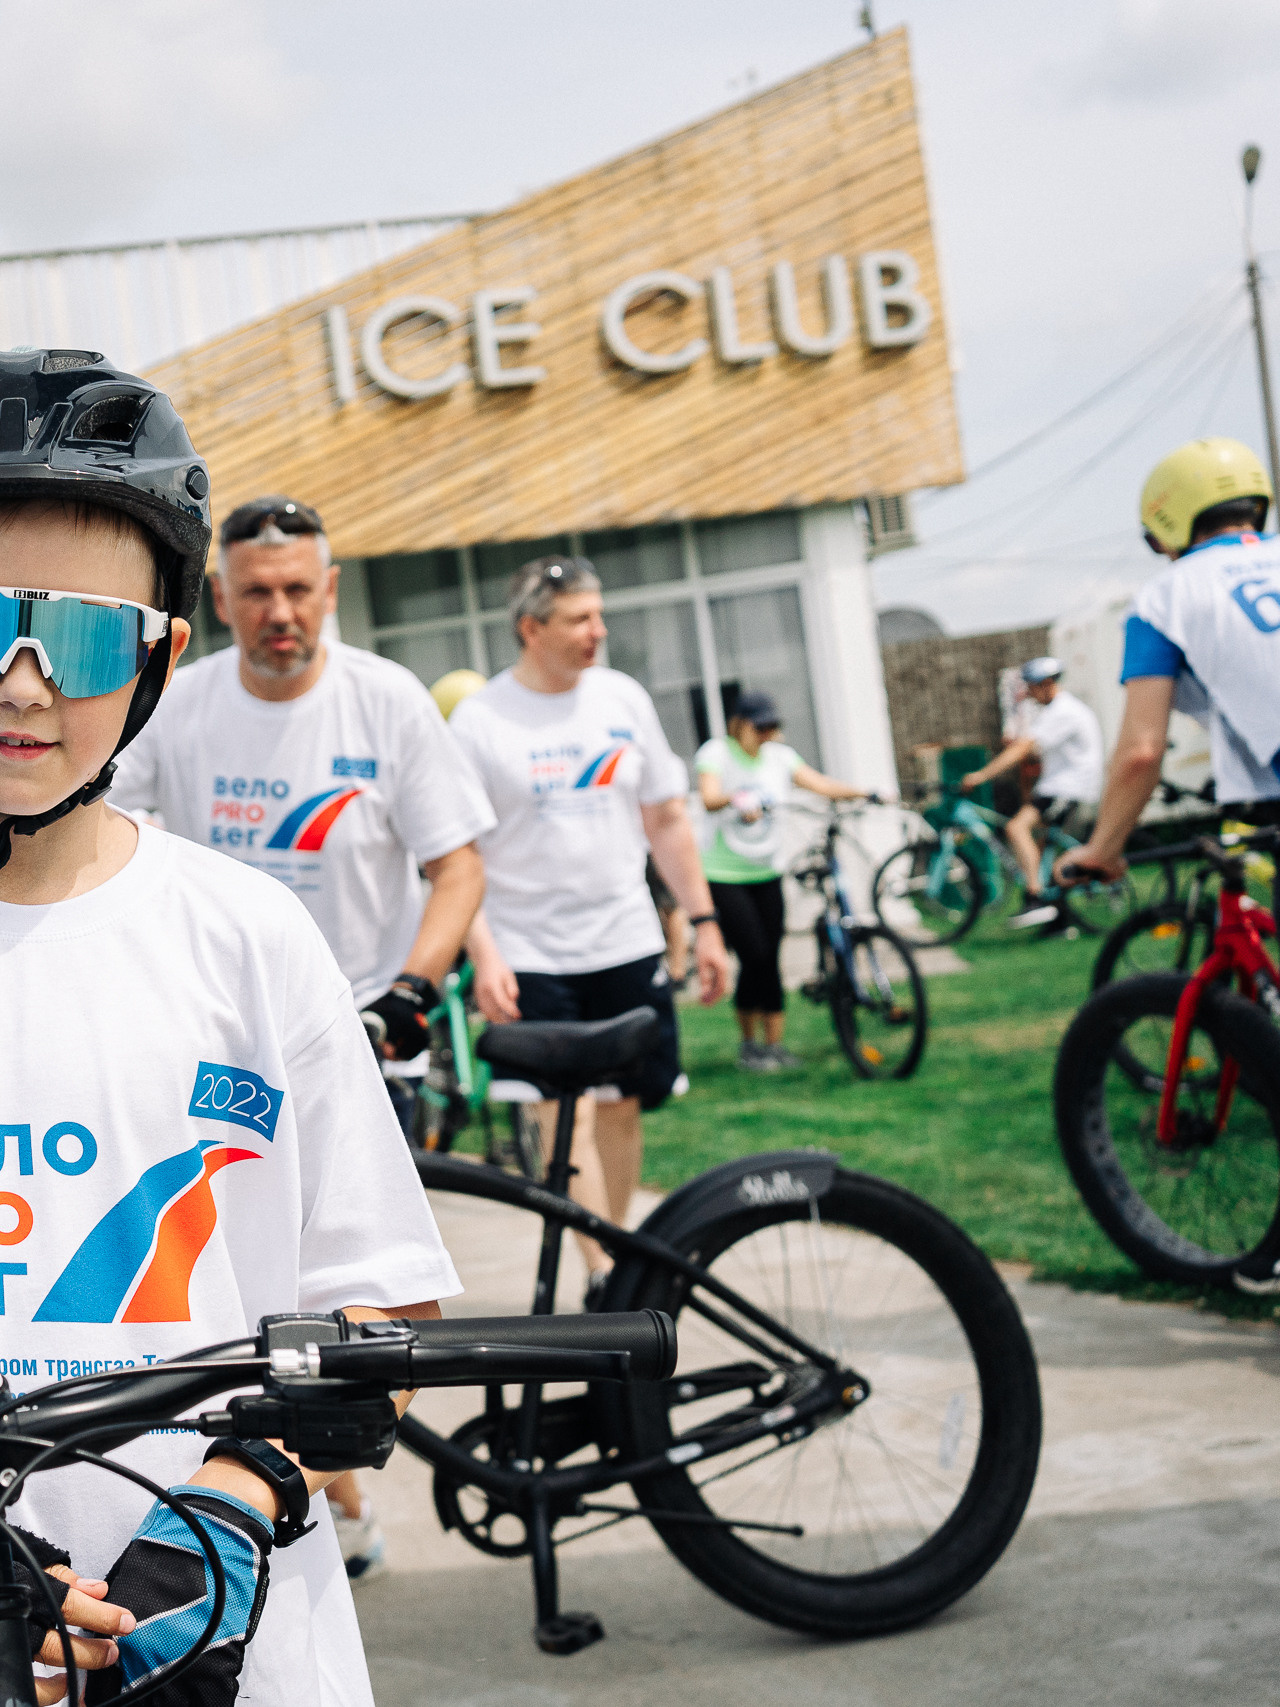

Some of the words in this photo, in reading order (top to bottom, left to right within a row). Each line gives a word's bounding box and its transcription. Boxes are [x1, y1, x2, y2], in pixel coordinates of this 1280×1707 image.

[325, 285, 547, 402] ICE
[601, 249, 932, 373] CLUB
[27, 590, 50, 600] BLIZ
[195, 1073, 271, 1130] 2022
